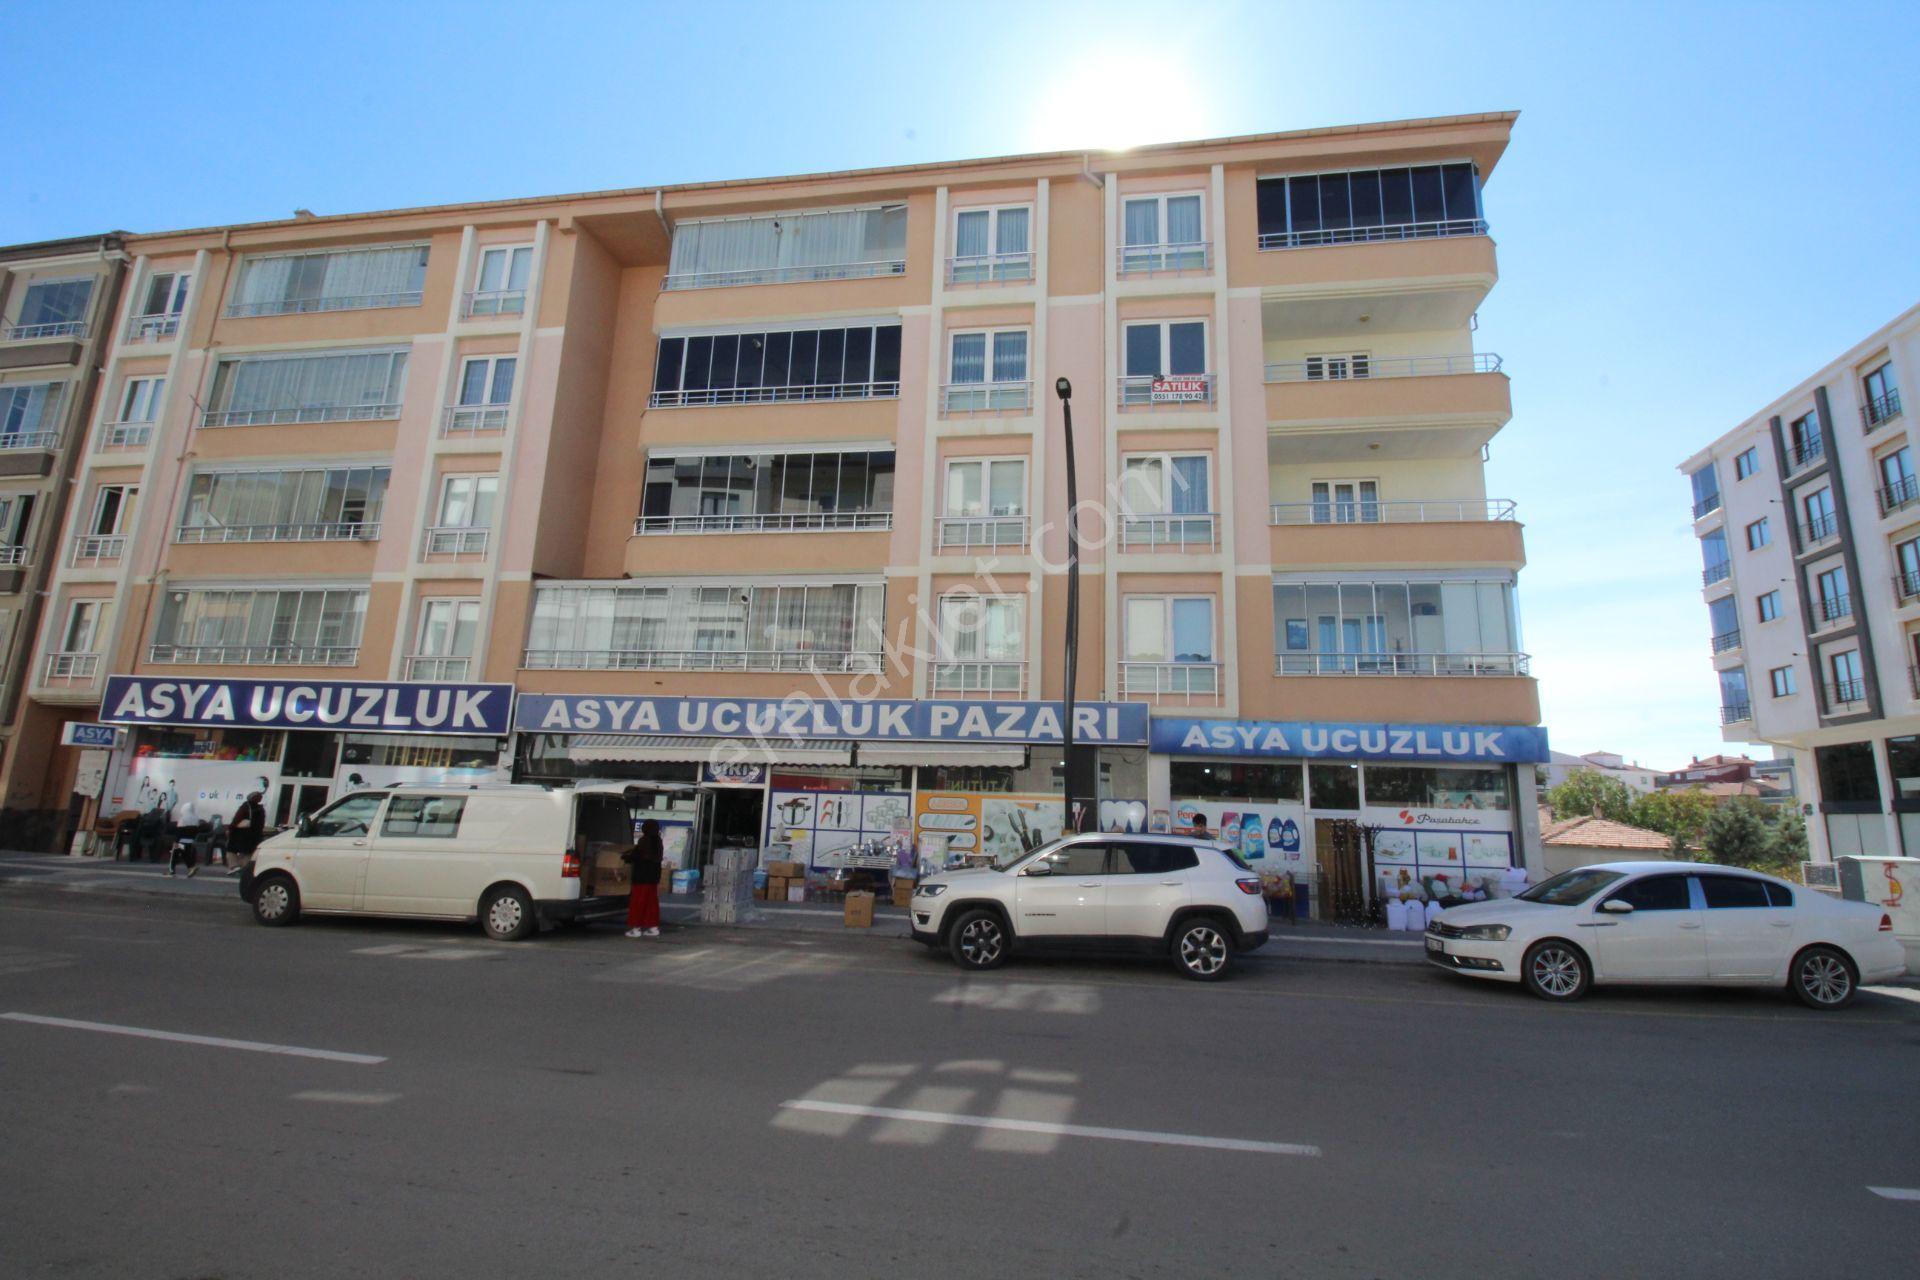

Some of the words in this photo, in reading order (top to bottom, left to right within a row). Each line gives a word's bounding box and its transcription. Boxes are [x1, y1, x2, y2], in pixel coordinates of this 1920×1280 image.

[1153, 381, 1201, 392] SATILIK
[113, 683, 236, 721] ASYA
[250, 687, 493, 729] UCUZLUK
[541, 699, 660, 730] ASYA
[678, 702, 912, 737] UCUZLUK
[930, 705, 1119, 740] PAZARI
[75, 726, 113, 739] ASYA
[1181, 724, 1291, 752] ASYA
[1302, 729, 1506, 757] UCUZLUK
